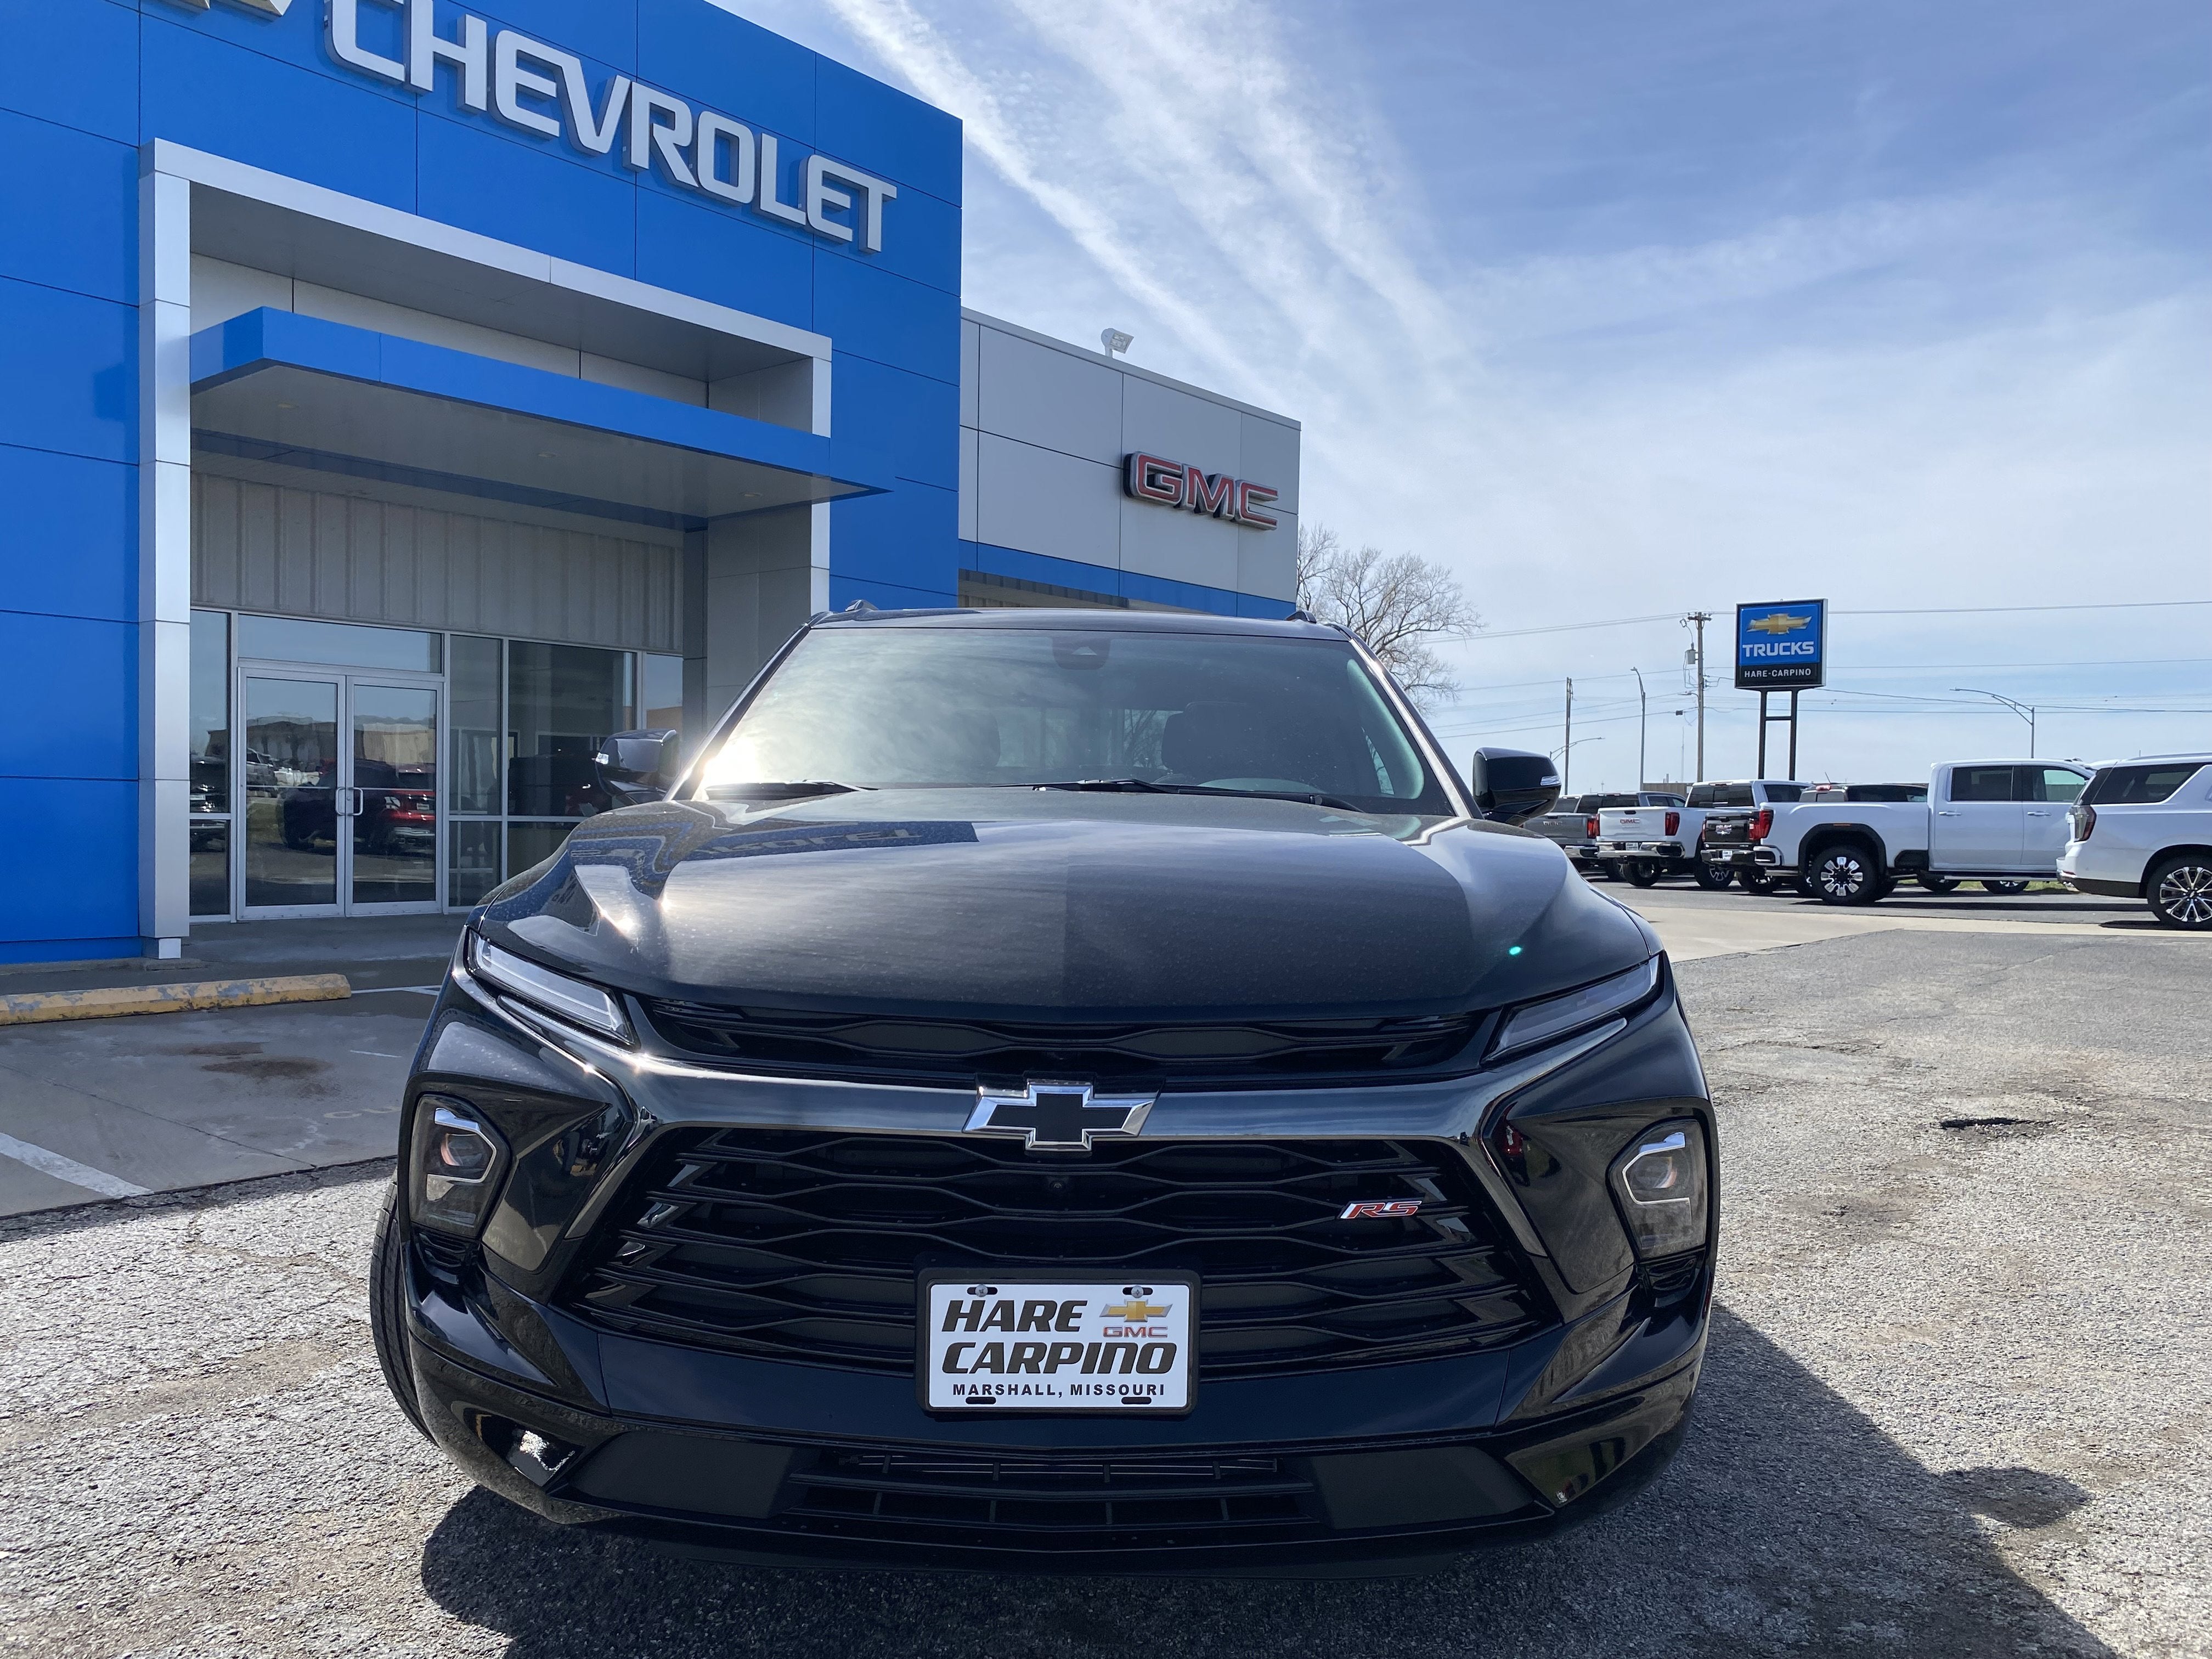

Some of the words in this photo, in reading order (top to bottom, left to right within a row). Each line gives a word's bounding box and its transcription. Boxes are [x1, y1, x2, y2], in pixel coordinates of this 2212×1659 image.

[328, 0, 898, 253] CHEVROLET
[1128, 451, 1278, 530] GMC
[1742, 641, 1815, 657] TRUCKS
[1744, 668, 1812, 678] HARE-CARPINO
[1340, 1200, 1423, 1219] RS
[941, 1300, 1088, 1332] HARE
[1103, 1325, 1169, 1338] GMC
[941, 1342, 1177, 1374] CARPINO
[952, 1384, 1063, 1398] MARSHALL,
[1070, 1384, 1165, 1396] MISSOURI
